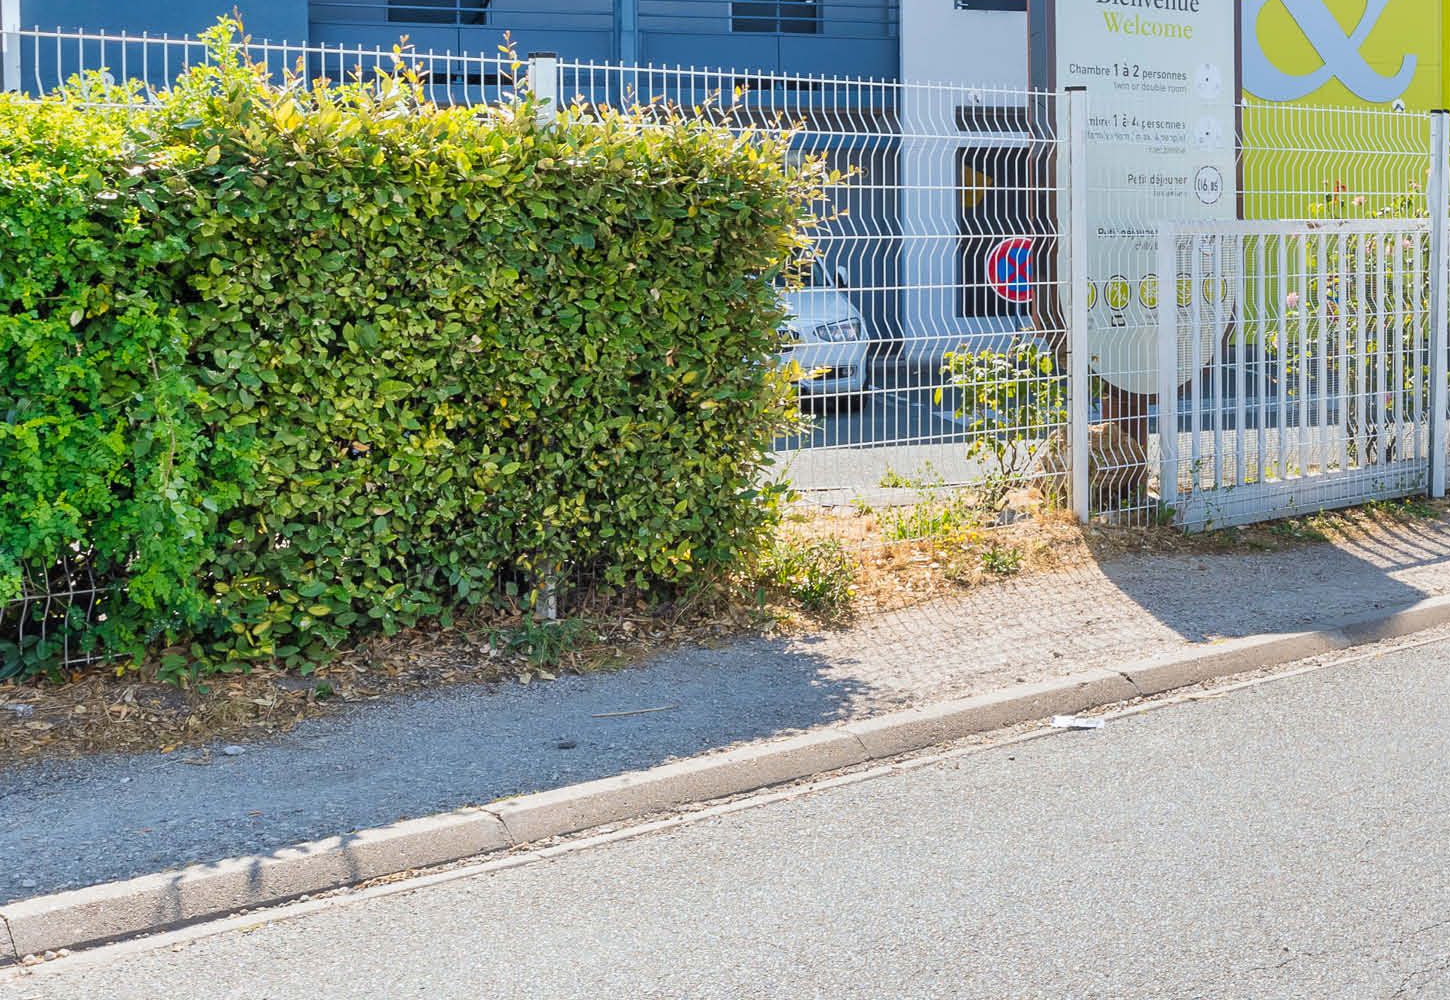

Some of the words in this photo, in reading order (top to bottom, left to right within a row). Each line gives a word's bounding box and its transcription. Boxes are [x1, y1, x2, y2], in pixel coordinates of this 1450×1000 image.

[1103, 11, 1193, 40] Welcome
[1069, 63, 1111, 77] Chambre
[1113, 63, 1119, 77] 1
[1122, 62, 1129, 77] à
[1132, 64, 1140, 78] 2
[1142, 69, 1187, 81] personnes
[1113, 113, 1119, 128] 1
